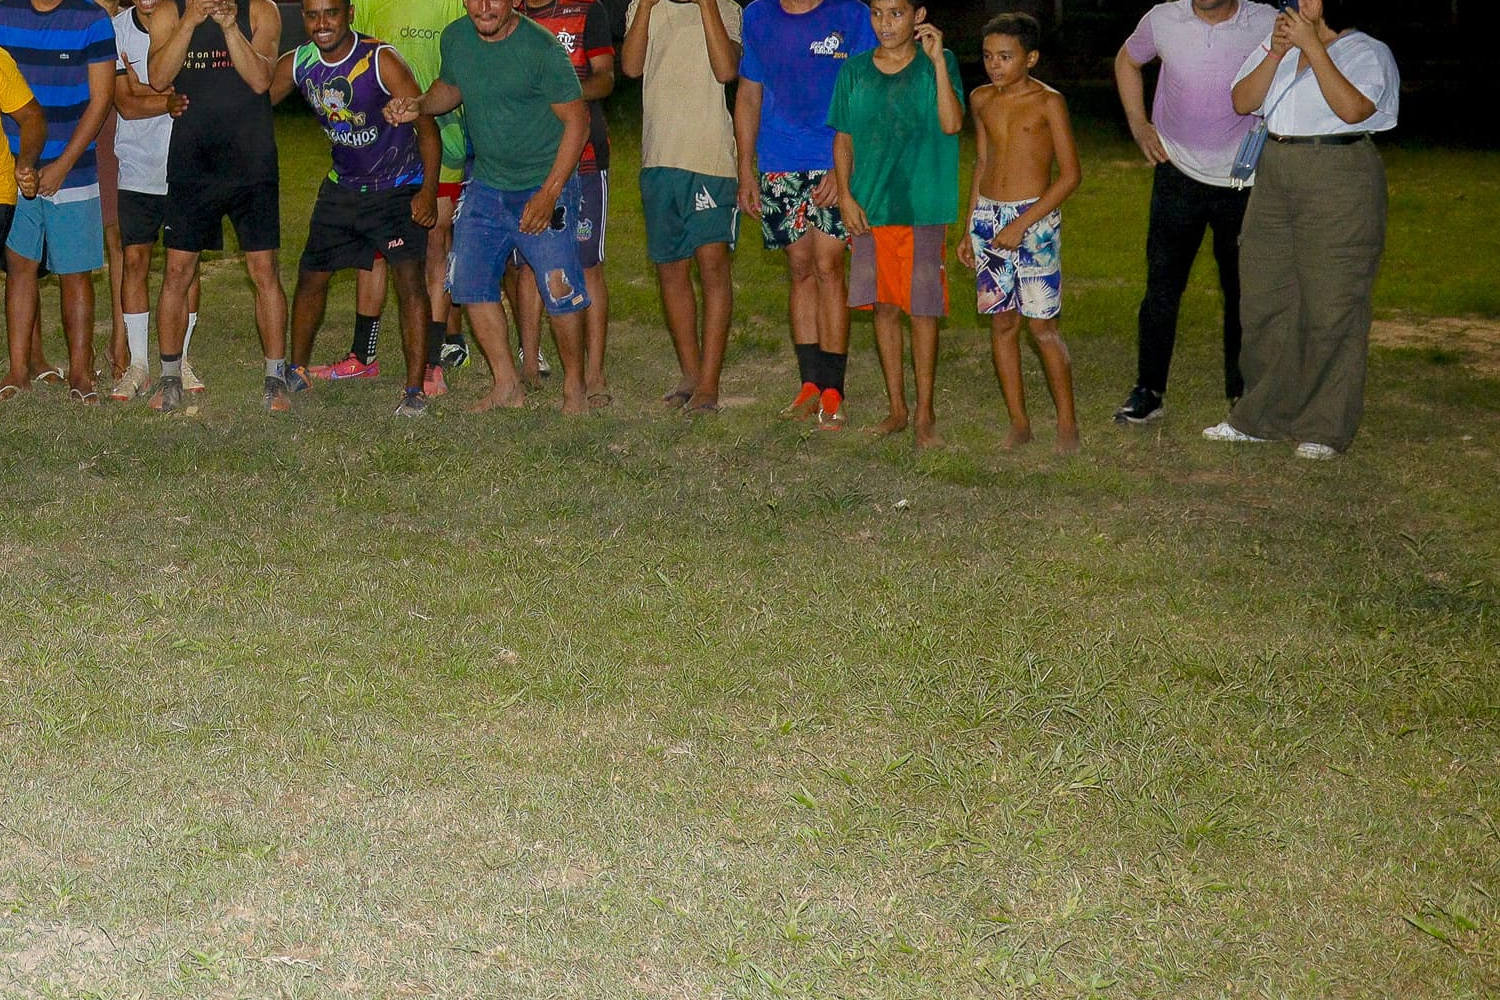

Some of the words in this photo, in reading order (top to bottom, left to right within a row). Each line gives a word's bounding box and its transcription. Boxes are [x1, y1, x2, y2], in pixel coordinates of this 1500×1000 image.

[400, 26, 440, 40] decor
[197, 51, 209, 59] on
[211, 50, 227, 58] the
[388, 238, 404, 249] FILA
